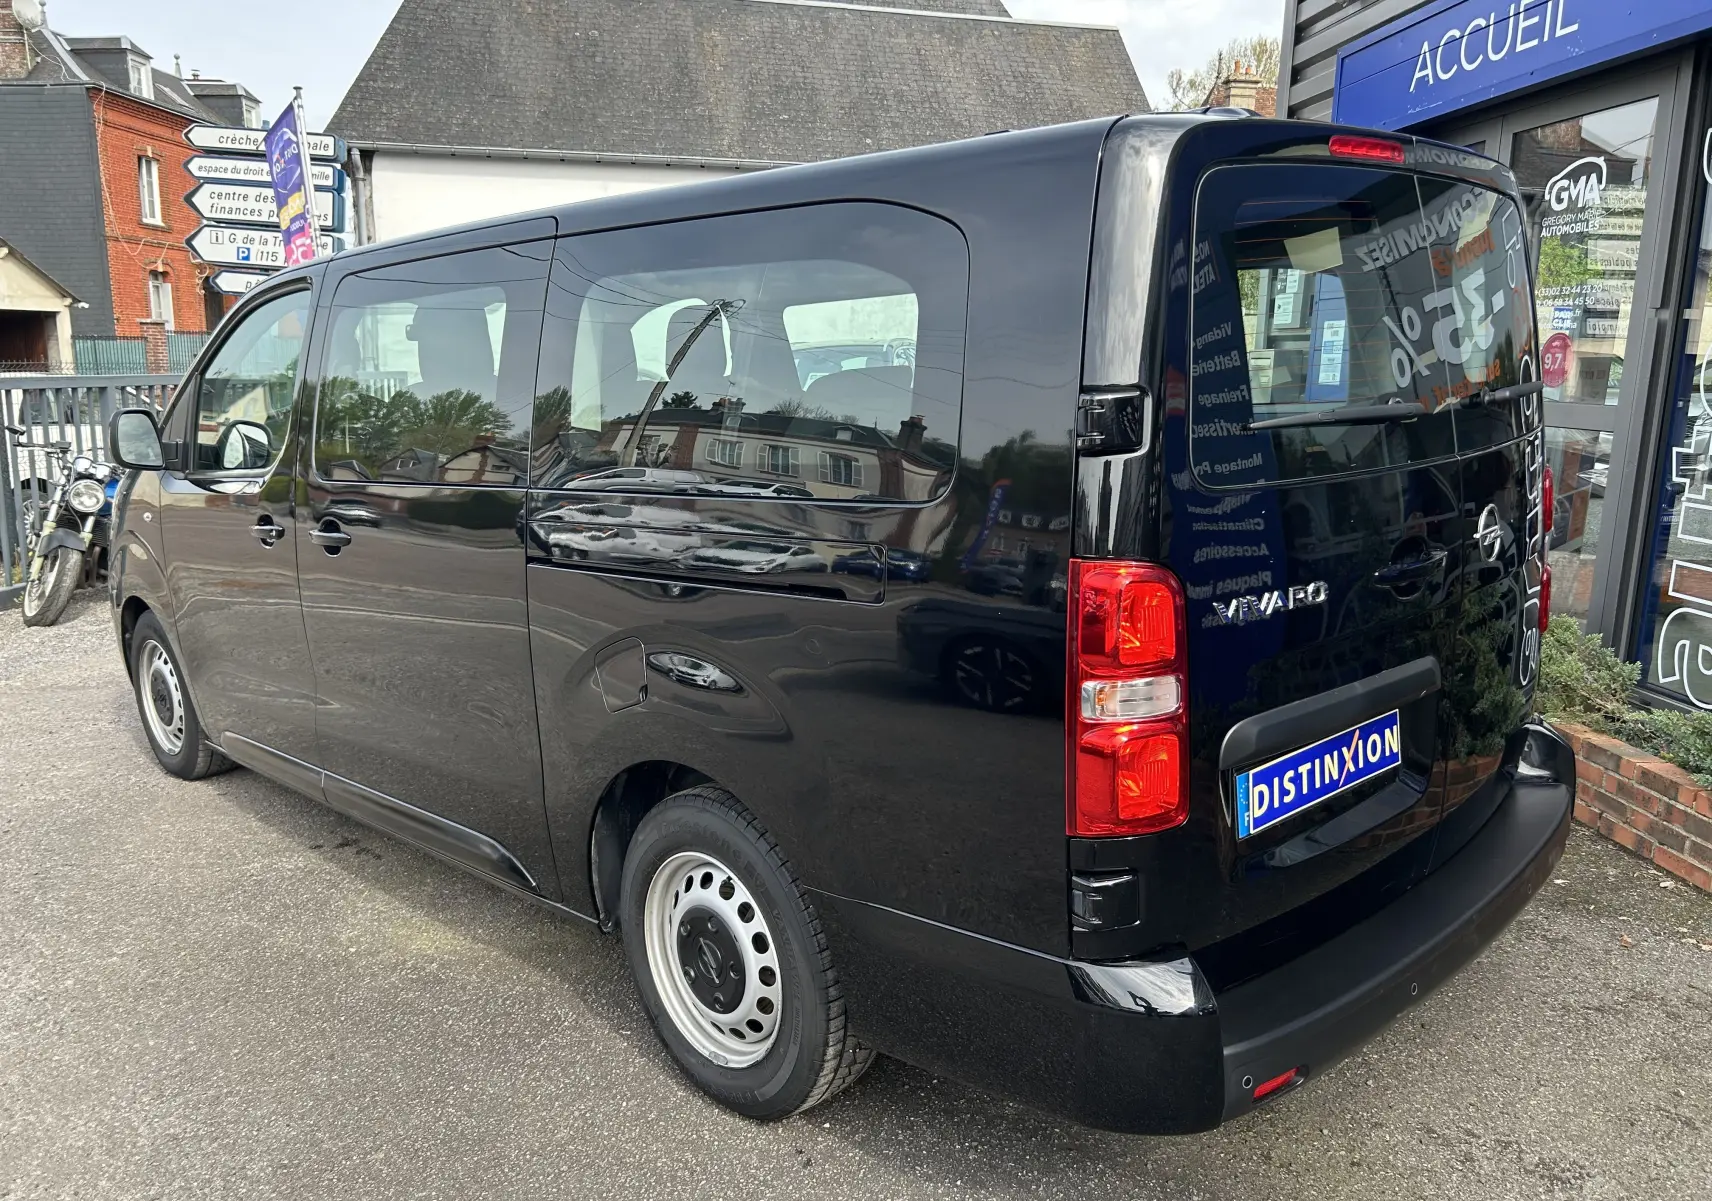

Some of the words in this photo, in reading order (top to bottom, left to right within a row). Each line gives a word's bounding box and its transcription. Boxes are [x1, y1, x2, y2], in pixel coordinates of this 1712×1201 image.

[1410, 0, 1579, 92] ACCUEIL
[218, 134, 259, 147] crèche
[198, 165, 229, 175] espace
[231, 165, 242, 175] du
[243, 166, 264, 176] droit
[209, 191, 249, 202] centre
[254, 192, 275, 204] des
[1550, 172, 1600, 211] GMA
[209, 204, 263, 218] finances
[1542, 213, 1577, 227] GREGORY
[1578, 209, 1601, 222] MARIE
[1540, 220, 1599, 238] AUTOMOBILES
[242, 234, 256, 245] de
[258, 235, 271, 245] la
[255, 251, 278, 263] (115
[1571, 286, 1581, 294] 44
[1582, 285, 1592, 293] 23
[1574, 297, 1584, 305] 45
[1584, 296, 1595, 305] 50
[1212, 580, 1329, 624] VIVARO
[1253, 725, 1399, 818] DISTINXION
